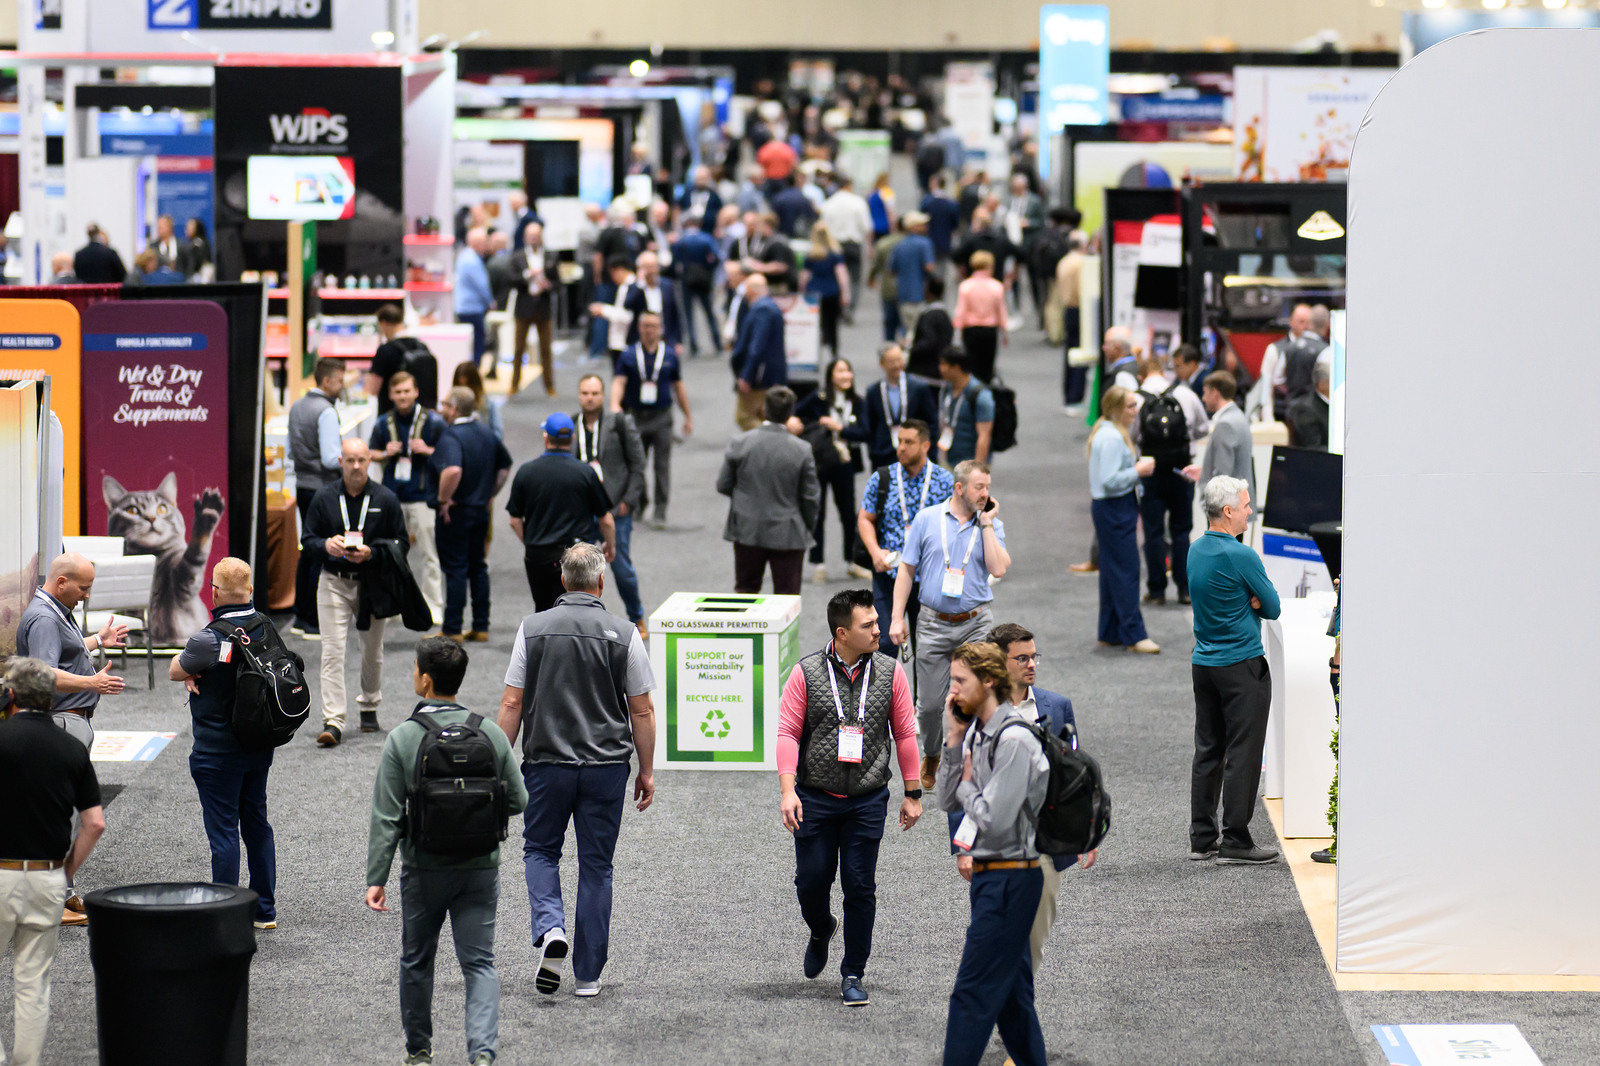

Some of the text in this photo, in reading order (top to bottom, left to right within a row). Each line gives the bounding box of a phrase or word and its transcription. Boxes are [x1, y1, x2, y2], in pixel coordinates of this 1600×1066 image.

[210, 0, 322, 18] ZINPRO
[269, 114, 349, 144] WJPS
[2, 336, 55, 347] HEALTH BENEFITS
[116, 337, 193, 348] FORMULA FUNCTIONALITY
[118, 364, 203, 388] Wet & Dry
[129, 384, 196, 407] Treats &
[113, 403, 209, 428] Supplements
[661, 620, 769, 630] NO GLASSWARE PERMITTED
[685, 651, 727, 660] SUPPORT
[685, 661, 745, 672] Sustainability
[698, 671, 731, 681] Mission
[685, 694, 744, 703] RECYCLE HERE.
